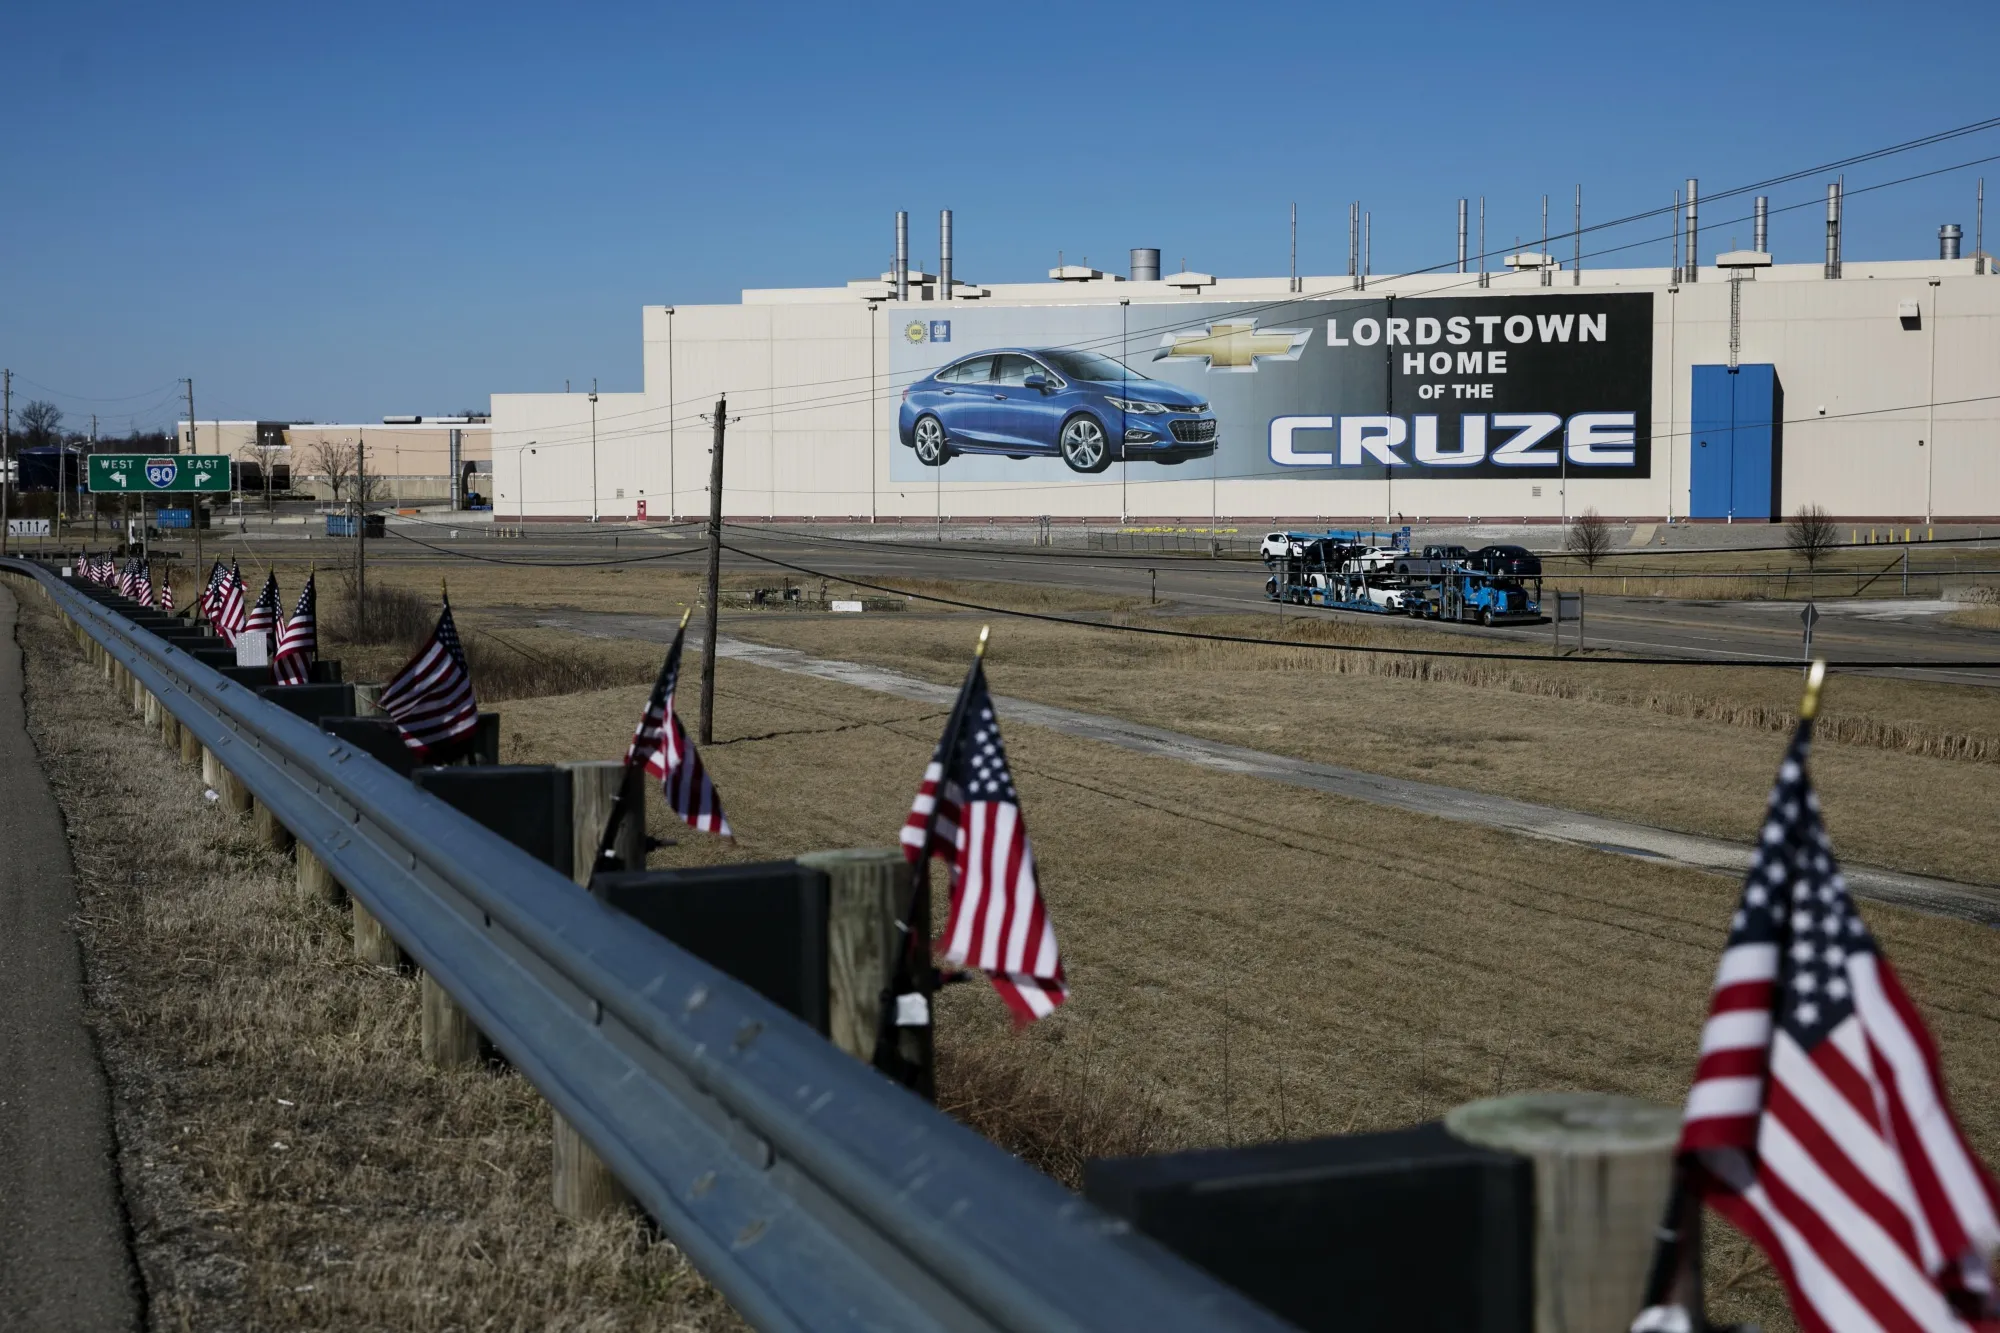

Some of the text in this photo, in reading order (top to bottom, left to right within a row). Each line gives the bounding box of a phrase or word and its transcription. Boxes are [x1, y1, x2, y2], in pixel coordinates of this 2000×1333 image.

[1327, 313, 1606, 346] LORDSTOWN
[1403, 351, 1507, 375] HOME
[1418, 384, 1494, 399] OF THE
[1268, 411, 1636, 468] CRUZE
[100, 460, 134, 469] WEST
[187, 460, 219, 469] EAST
[150, 467, 173, 482] 80
